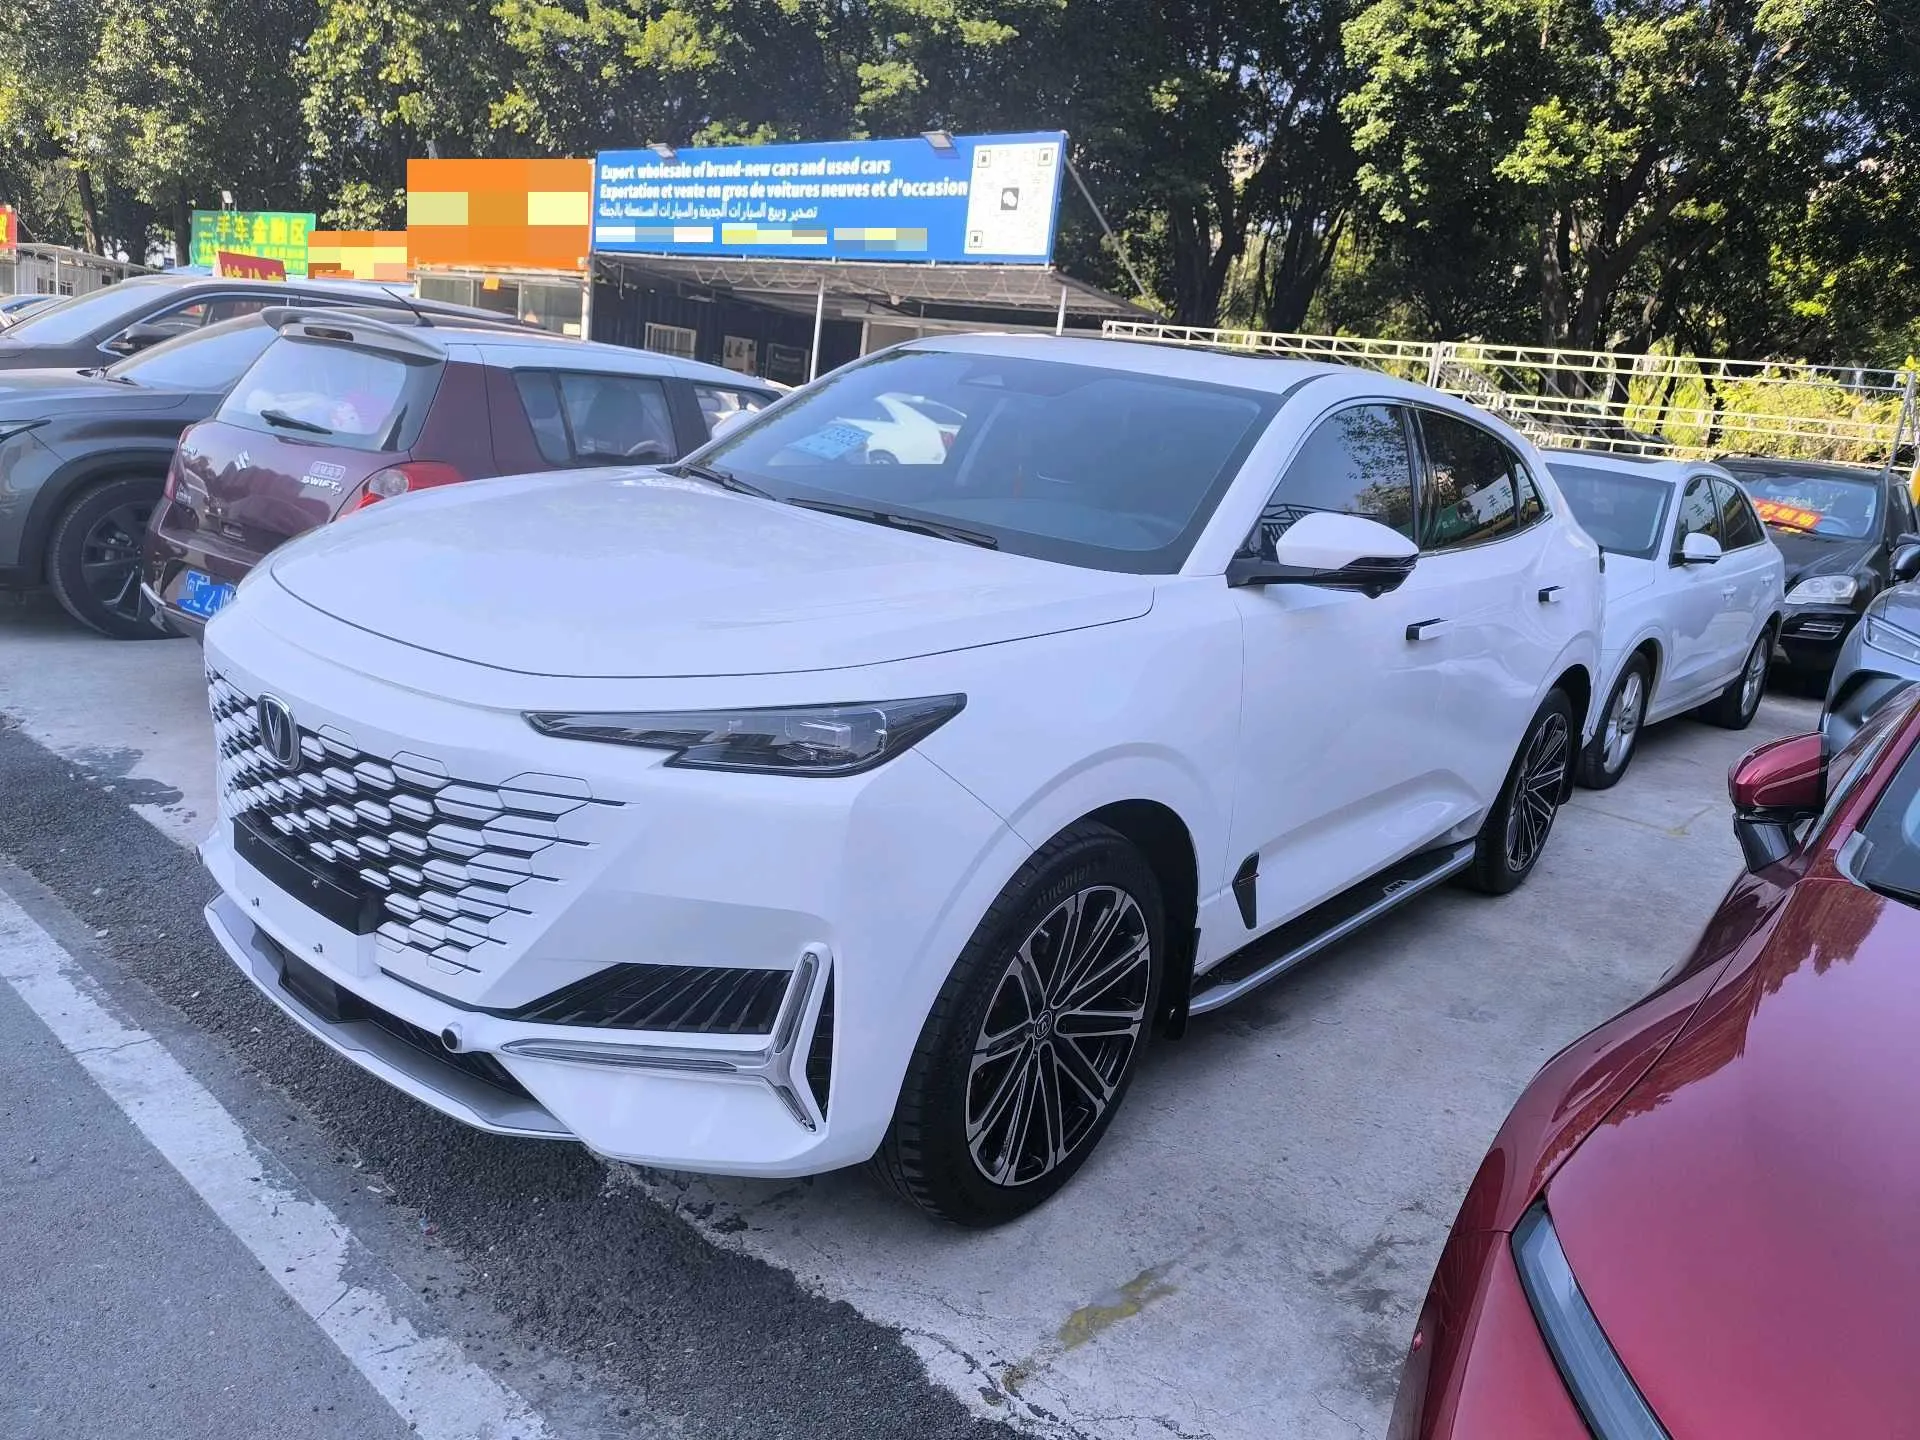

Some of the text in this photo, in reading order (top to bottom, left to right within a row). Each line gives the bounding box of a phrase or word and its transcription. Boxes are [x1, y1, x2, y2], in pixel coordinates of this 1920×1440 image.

[601, 156, 891, 182] Export wholesale of brand-new cars and used cars
[600, 176, 968, 201] Exportation et vente en gros de voitures neuves et d'occasion
[301, 475, 339, 489] SWIFT
